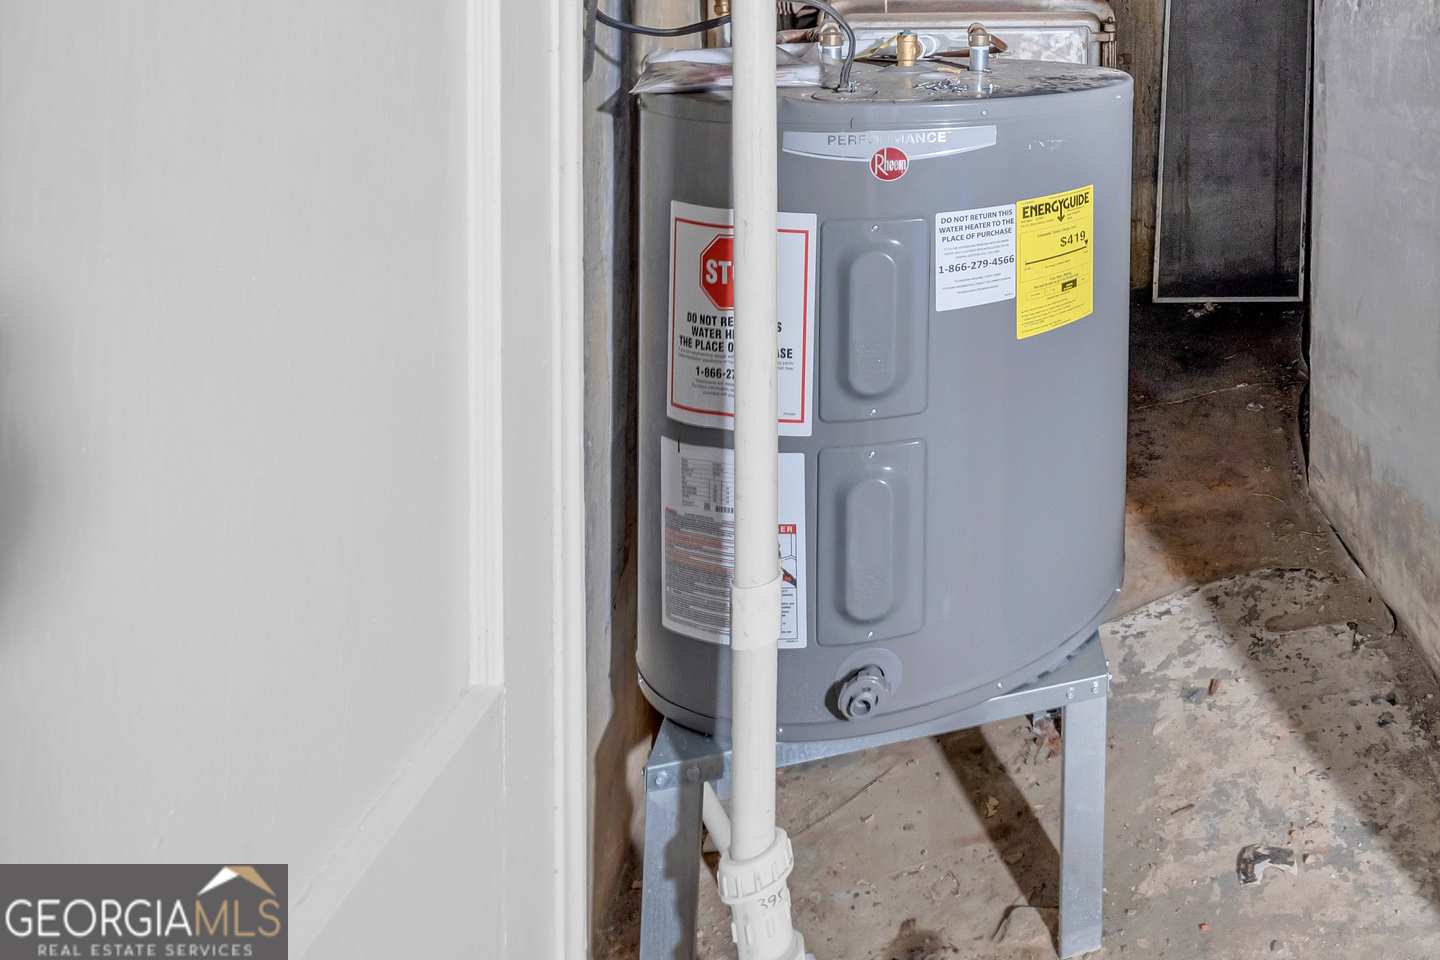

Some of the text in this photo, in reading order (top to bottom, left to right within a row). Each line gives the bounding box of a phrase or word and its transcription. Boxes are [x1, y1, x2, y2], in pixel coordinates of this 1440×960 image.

[873, 147, 907, 177] Rheem
[1023, 192, 1089, 220] ENERGYGUIDE
[954, 215, 968, 223] NOT
[970, 212, 997, 221] RETURN
[939, 224, 964, 234] WATER
[965, 221, 991, 232] HEATER
[942, 234, 964, 242] PLACE
[977, 228, 1012, 239] PURCHASE
[1060, 231, 1085, 247] $419
[706, 259, 734, 285] ST
[939, 255, 1015, 274] 1-866-279-4566
[687, 312, 697, 323] DO
[700, 315, 717, 326] NOT
[692, 325, 721, 339] WATER
[680, 335, 734, 352] THE PLACE O
